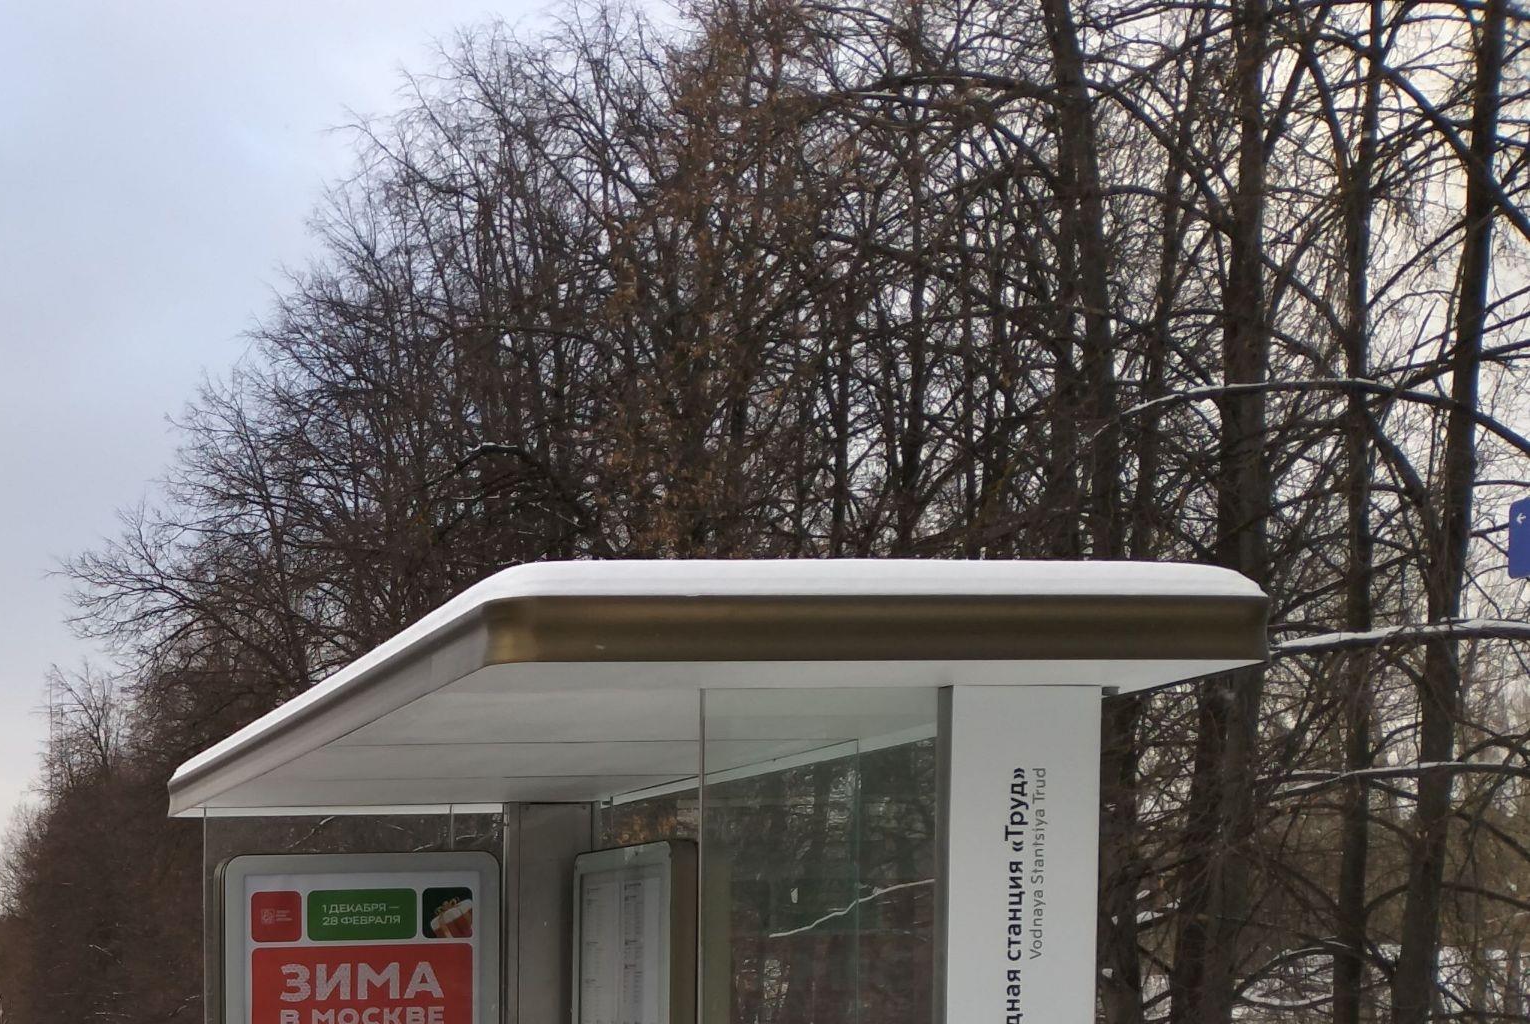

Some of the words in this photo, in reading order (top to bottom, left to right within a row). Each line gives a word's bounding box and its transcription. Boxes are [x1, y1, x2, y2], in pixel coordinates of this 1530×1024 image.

[1005, 767, 1030, 852] «Труд»
[1031, 767, 1047, 803] Trud
[1030, 807, 1047, 883] Stantsiya
[322, 917, 338, 926] 28
[340, 915, 401, 925] ФЕВРАЛЯ
[328, 903, 387, 914] ДЕКАБРЯ
[1006, 860, 1025, 961] станция
[1029, 889, 1047, 960] Vodnaya
[280, 961, 444, 1002] ЗИМА
